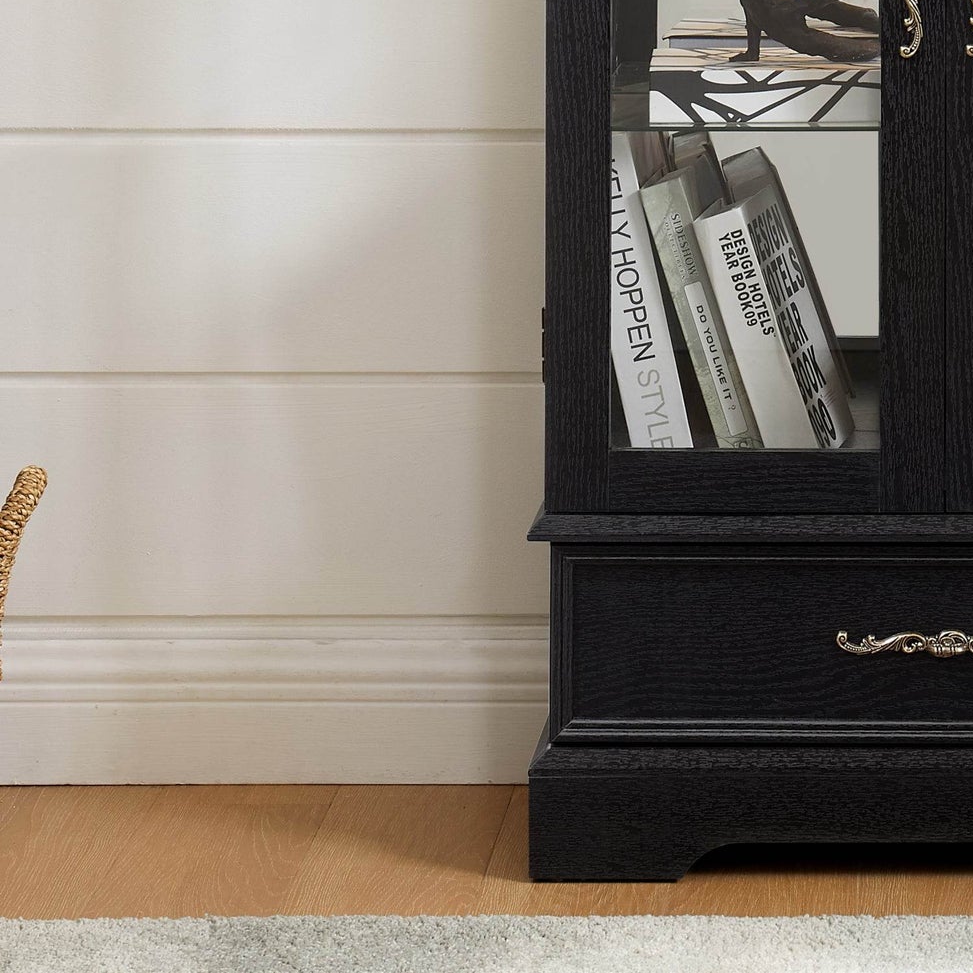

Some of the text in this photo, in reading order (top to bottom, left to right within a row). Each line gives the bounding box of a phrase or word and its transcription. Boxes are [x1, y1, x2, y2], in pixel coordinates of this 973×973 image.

[671, 213, 698, 276] SIDESHOW
[719, 232, 739, 270] YEAR
[730, 228, 757, 280] DESIGN
[747, 203, 789, 266] DESIGN
[761, 246, 805, 311] HOTELS
[611, 247, 656, 363] HOPPEN
[637, 369, 674, 448] STYLE
[696, 304, 707, 323] DO
[704, 327, 718, 353] YOU
[713, 356, 728, 385] LIKE
[723, 388, 732, 400] IT
[791, 344, 827, 406] BOOK
